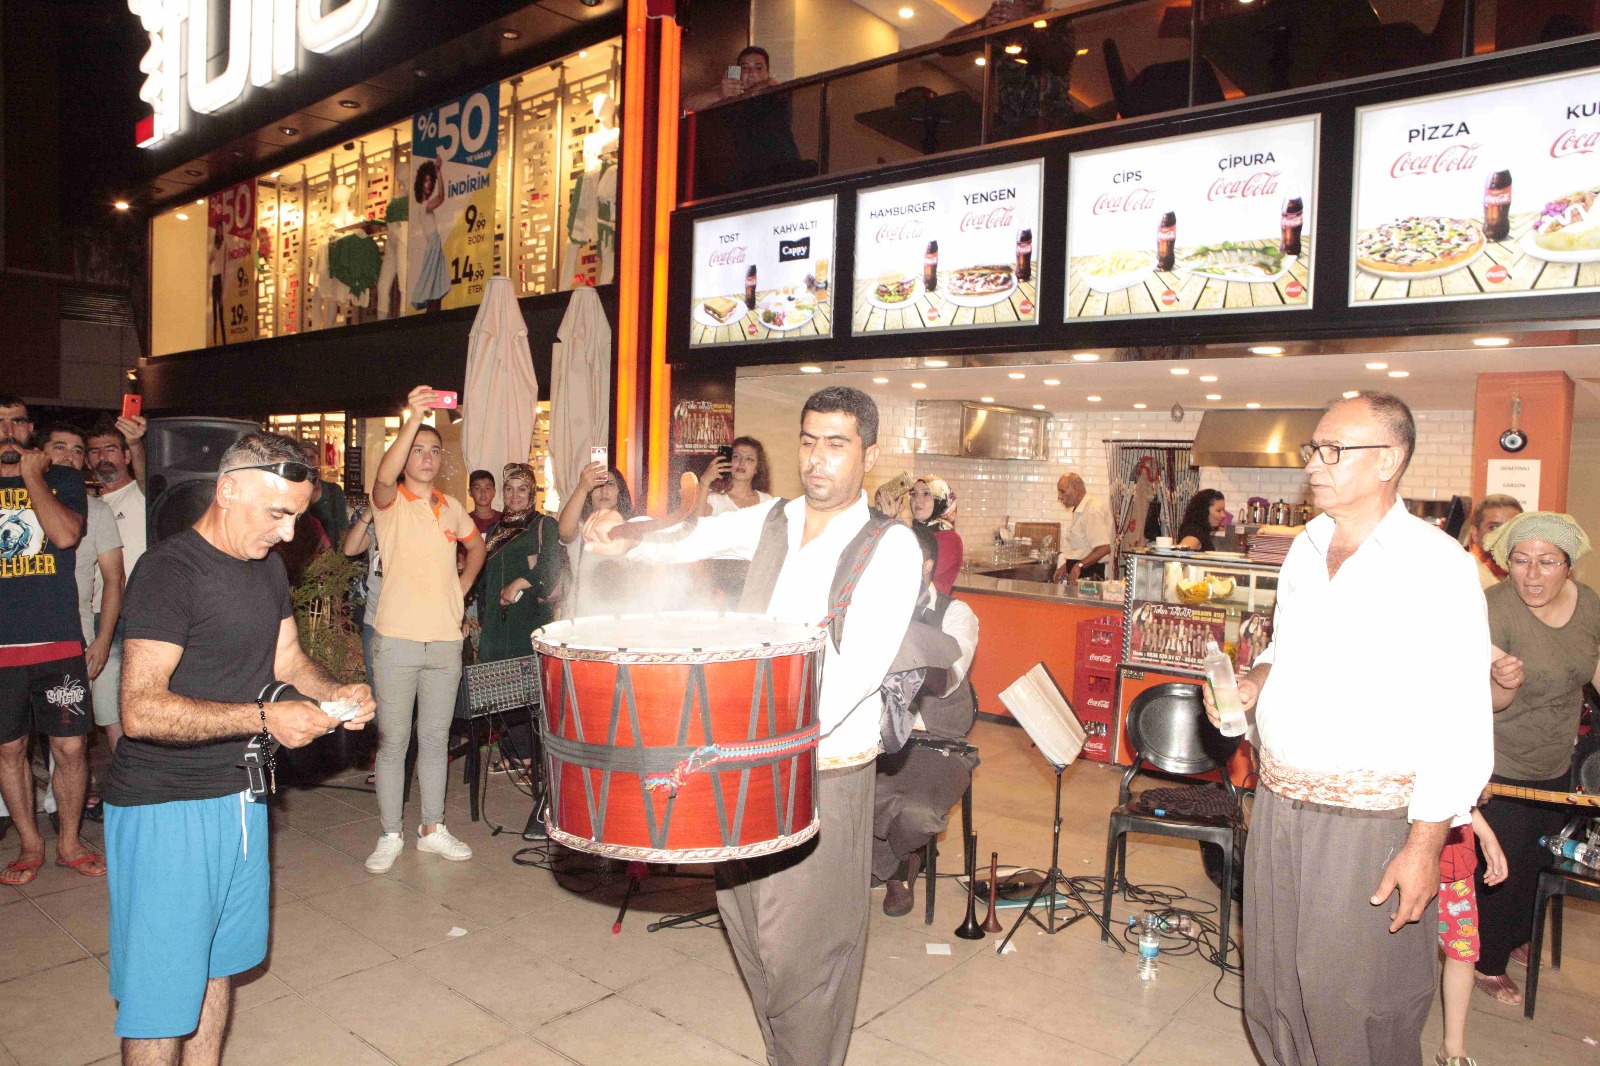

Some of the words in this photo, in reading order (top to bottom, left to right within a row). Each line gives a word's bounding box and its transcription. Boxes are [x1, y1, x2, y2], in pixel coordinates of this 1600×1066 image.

[1567, 101, 1600, 119] KU
[417, 92, 491, 162] %50
[1408, 121, 1470, 143] PİZZA
[1218, 151, 1275, 171] ÇİPURA
[1390, 142, 1483, 178] Coca-Cola
[448, 171, 490, 198] İNDİRİM
[1113, 170, 1142, 184] CİPS
[1207, 171, 1281, 201] Coca-Cola
[963, 188, 1016, 205] YENGEN
[1093, 188, 1156, 215] Coca-Cola
[870, 201, 935, 219] HAMBURGER
[960, 206, 1015, 232] Coca-Cola
[773, 220, 817, 235] KAHVALTI
[875, 219, 923, 243] Coca-Cola
[468, 234, 485, 245] BODY
[719, 233, 740, 244] TOST
[709, 247, 746, 267] Coca-Cola
[782, 246, 807, 257] Cappy
[467, 283, 484, 294] ETEK
[1089, 653, 1112, 663] Coca-Cola
